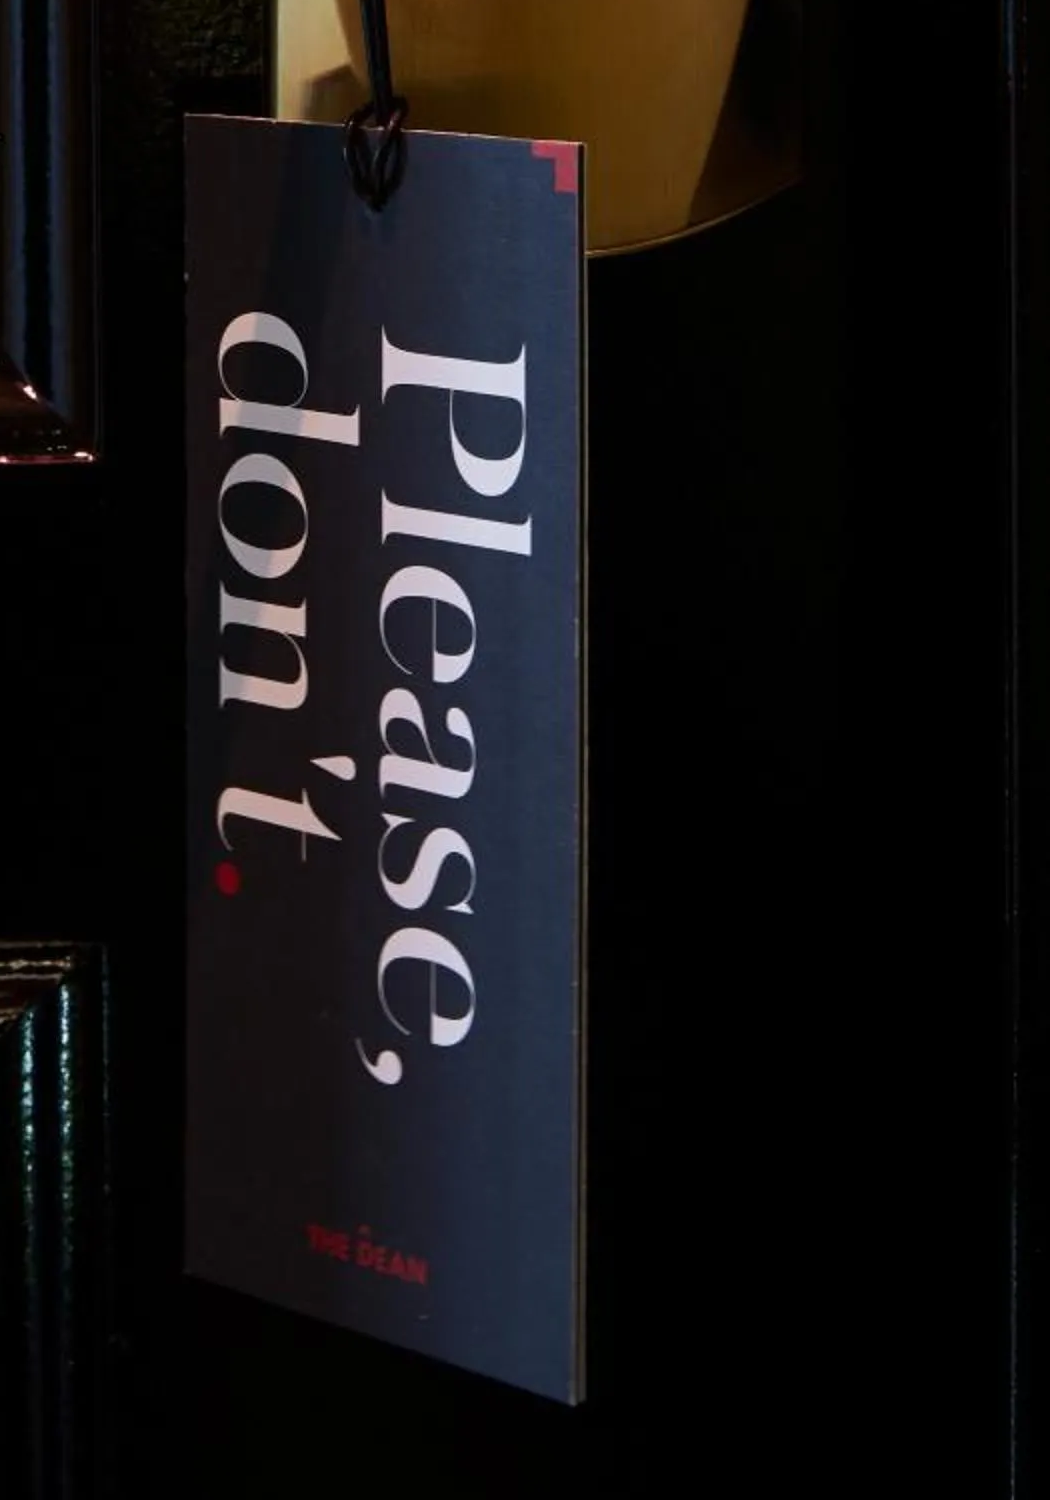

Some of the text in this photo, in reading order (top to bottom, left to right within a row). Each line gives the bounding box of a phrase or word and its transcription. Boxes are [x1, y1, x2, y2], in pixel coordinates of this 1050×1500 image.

[215, 311, 361, 897] don't.
[365, 326, 533, 1086] Please,
[305, 1222, 428, 1285] THE DEAN
